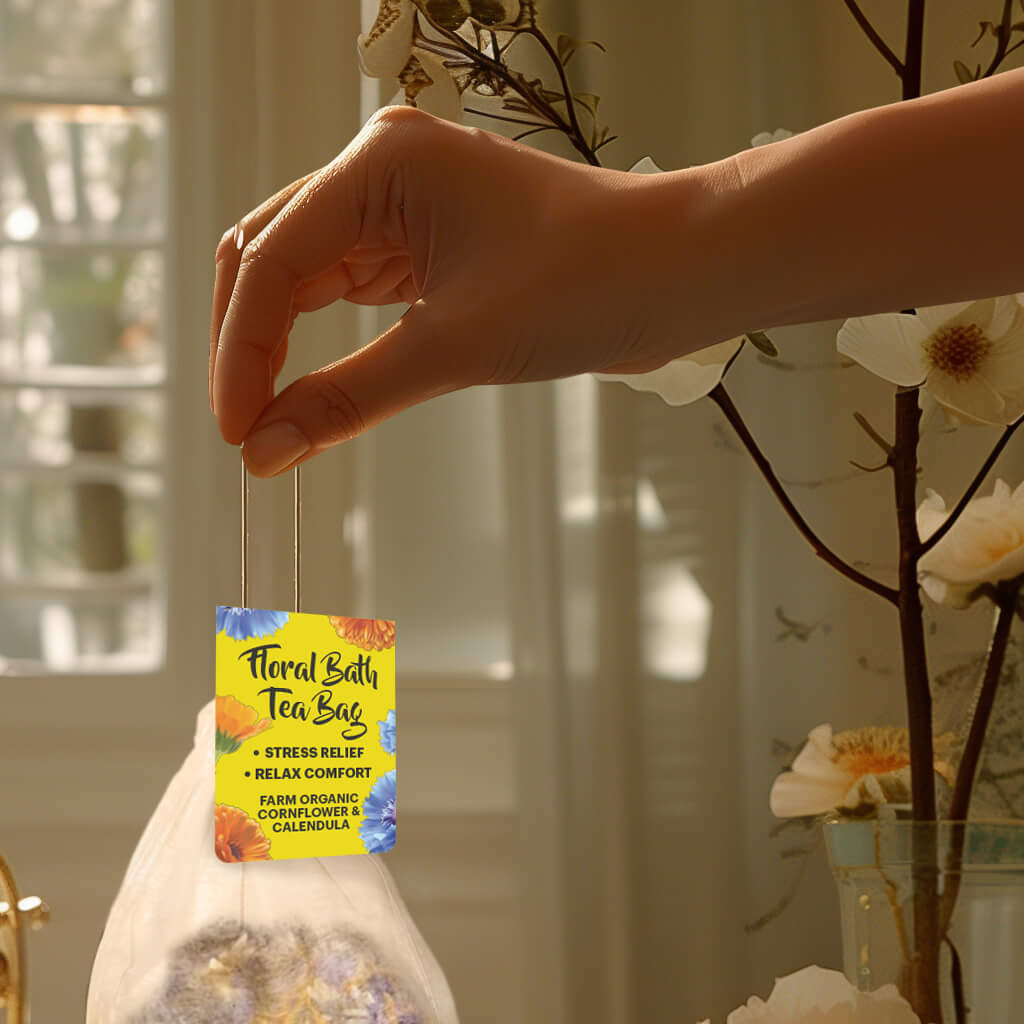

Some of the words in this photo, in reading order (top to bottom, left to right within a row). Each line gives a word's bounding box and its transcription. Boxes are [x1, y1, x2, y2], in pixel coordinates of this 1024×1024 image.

[238, 643, 317, 682] Floral
[320, 651, 378, 690] Bath
[257, 686, 310, 721] Tea
[311, 689, 368, 741] Bag
[265, 746, 318, 759] STRESS
[320, 746, 365, 759] RELIEF
[255, 767, 302, 780] RELAX
[304, 767, 372, 779] COMFORT
[260, 794, 297, 806] FARM
[299, 793, 359, 805] ORGANIC
[257, 807, 349, 820] CORNFLOWER
[351, 806, 360, 816] &
[272, 819, 350, 833] CALENDULA
